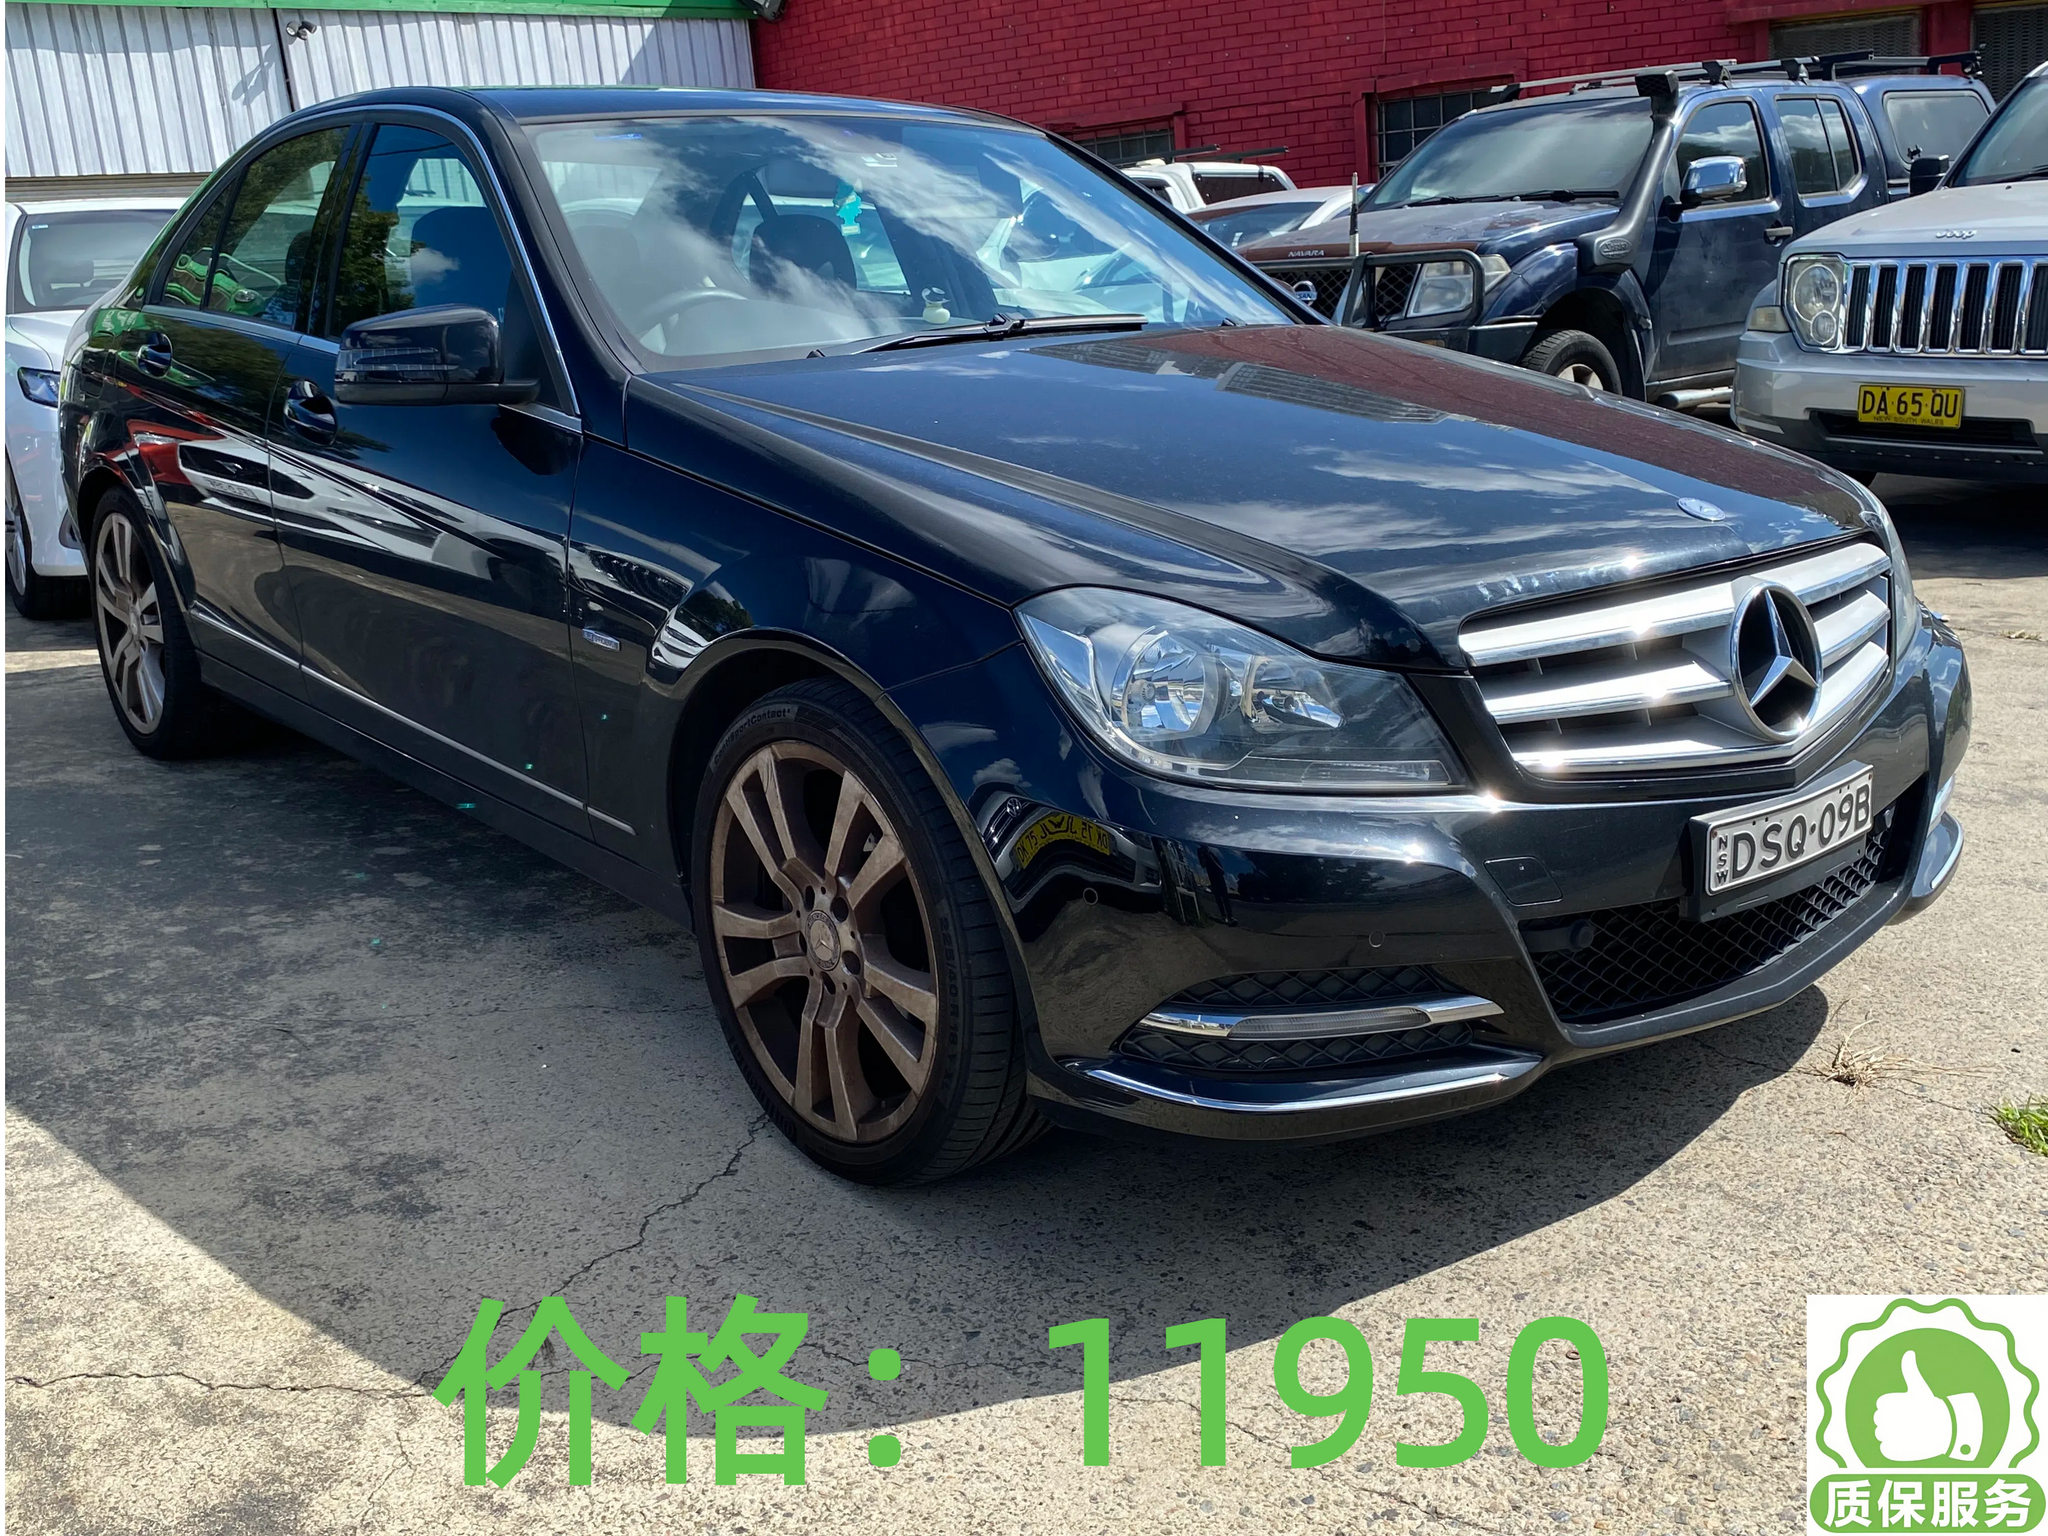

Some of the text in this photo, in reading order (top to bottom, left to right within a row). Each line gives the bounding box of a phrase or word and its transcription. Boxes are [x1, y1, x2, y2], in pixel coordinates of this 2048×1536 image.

[1288, 249, 1325, 257] NAVARA
[1894, 416, 1918, 424] SOUTH
[1921, 417, 1944, 426] WALES
[1716, 834, 1729, 886] NSW
[938, 916, 960, 998] 225/40
